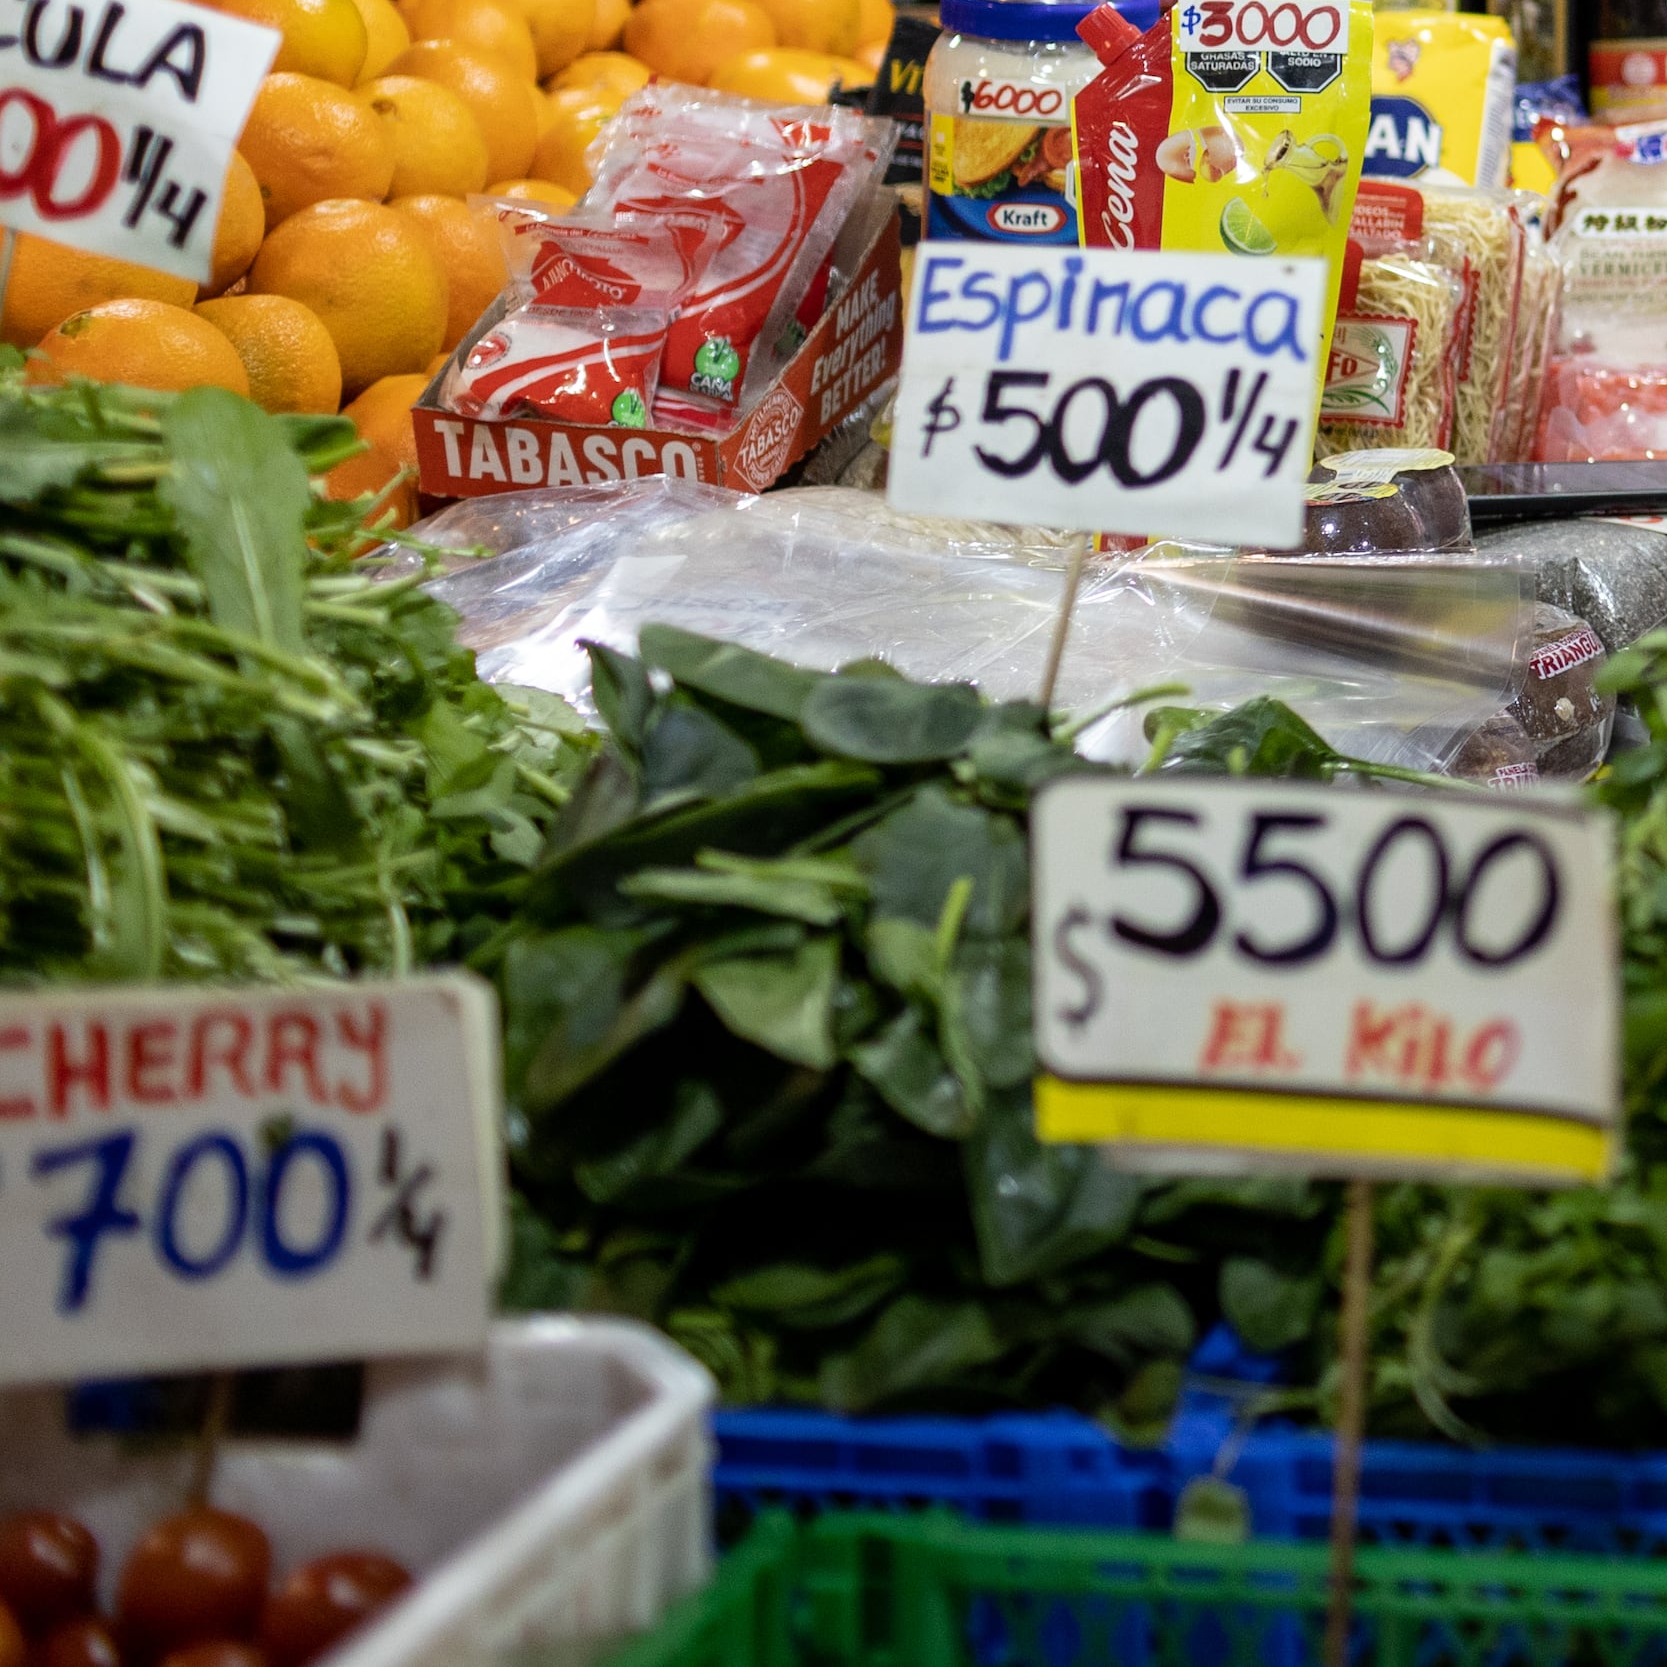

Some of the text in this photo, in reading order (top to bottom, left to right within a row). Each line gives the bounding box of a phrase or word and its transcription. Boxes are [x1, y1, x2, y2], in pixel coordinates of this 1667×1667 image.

[1181, 0, 1342, 51] $3000
[960, 80, 1063, 116] $6000
[1190, 60, 1256, 72] SATURADAS
[1287, 56, 1322, 68] SODIO
[1364, 114, 1443, 168] AN
[124, 126, 209, 249] 1/4
[1002, 208, 1049, 229] Kraft
[834, 267, 880, 339] MAKE
[918, 255, 1308, 366] Espinaca
[810, 290, 897, 397] Everything
[820, 336, 887, 426] BETTER!
[433, 419, 698, 487] TABASCO
[739, 406, 800, 469] TABASCO
[922, 370, 1208, 489] $500
[1218, 367, 1301, 479] 1/4
[1058, 803, 1563, 1034] $5500
[1198, 1001, 1297, 1074] EL
[32, 1122, 446, 1314] 700 1/4
